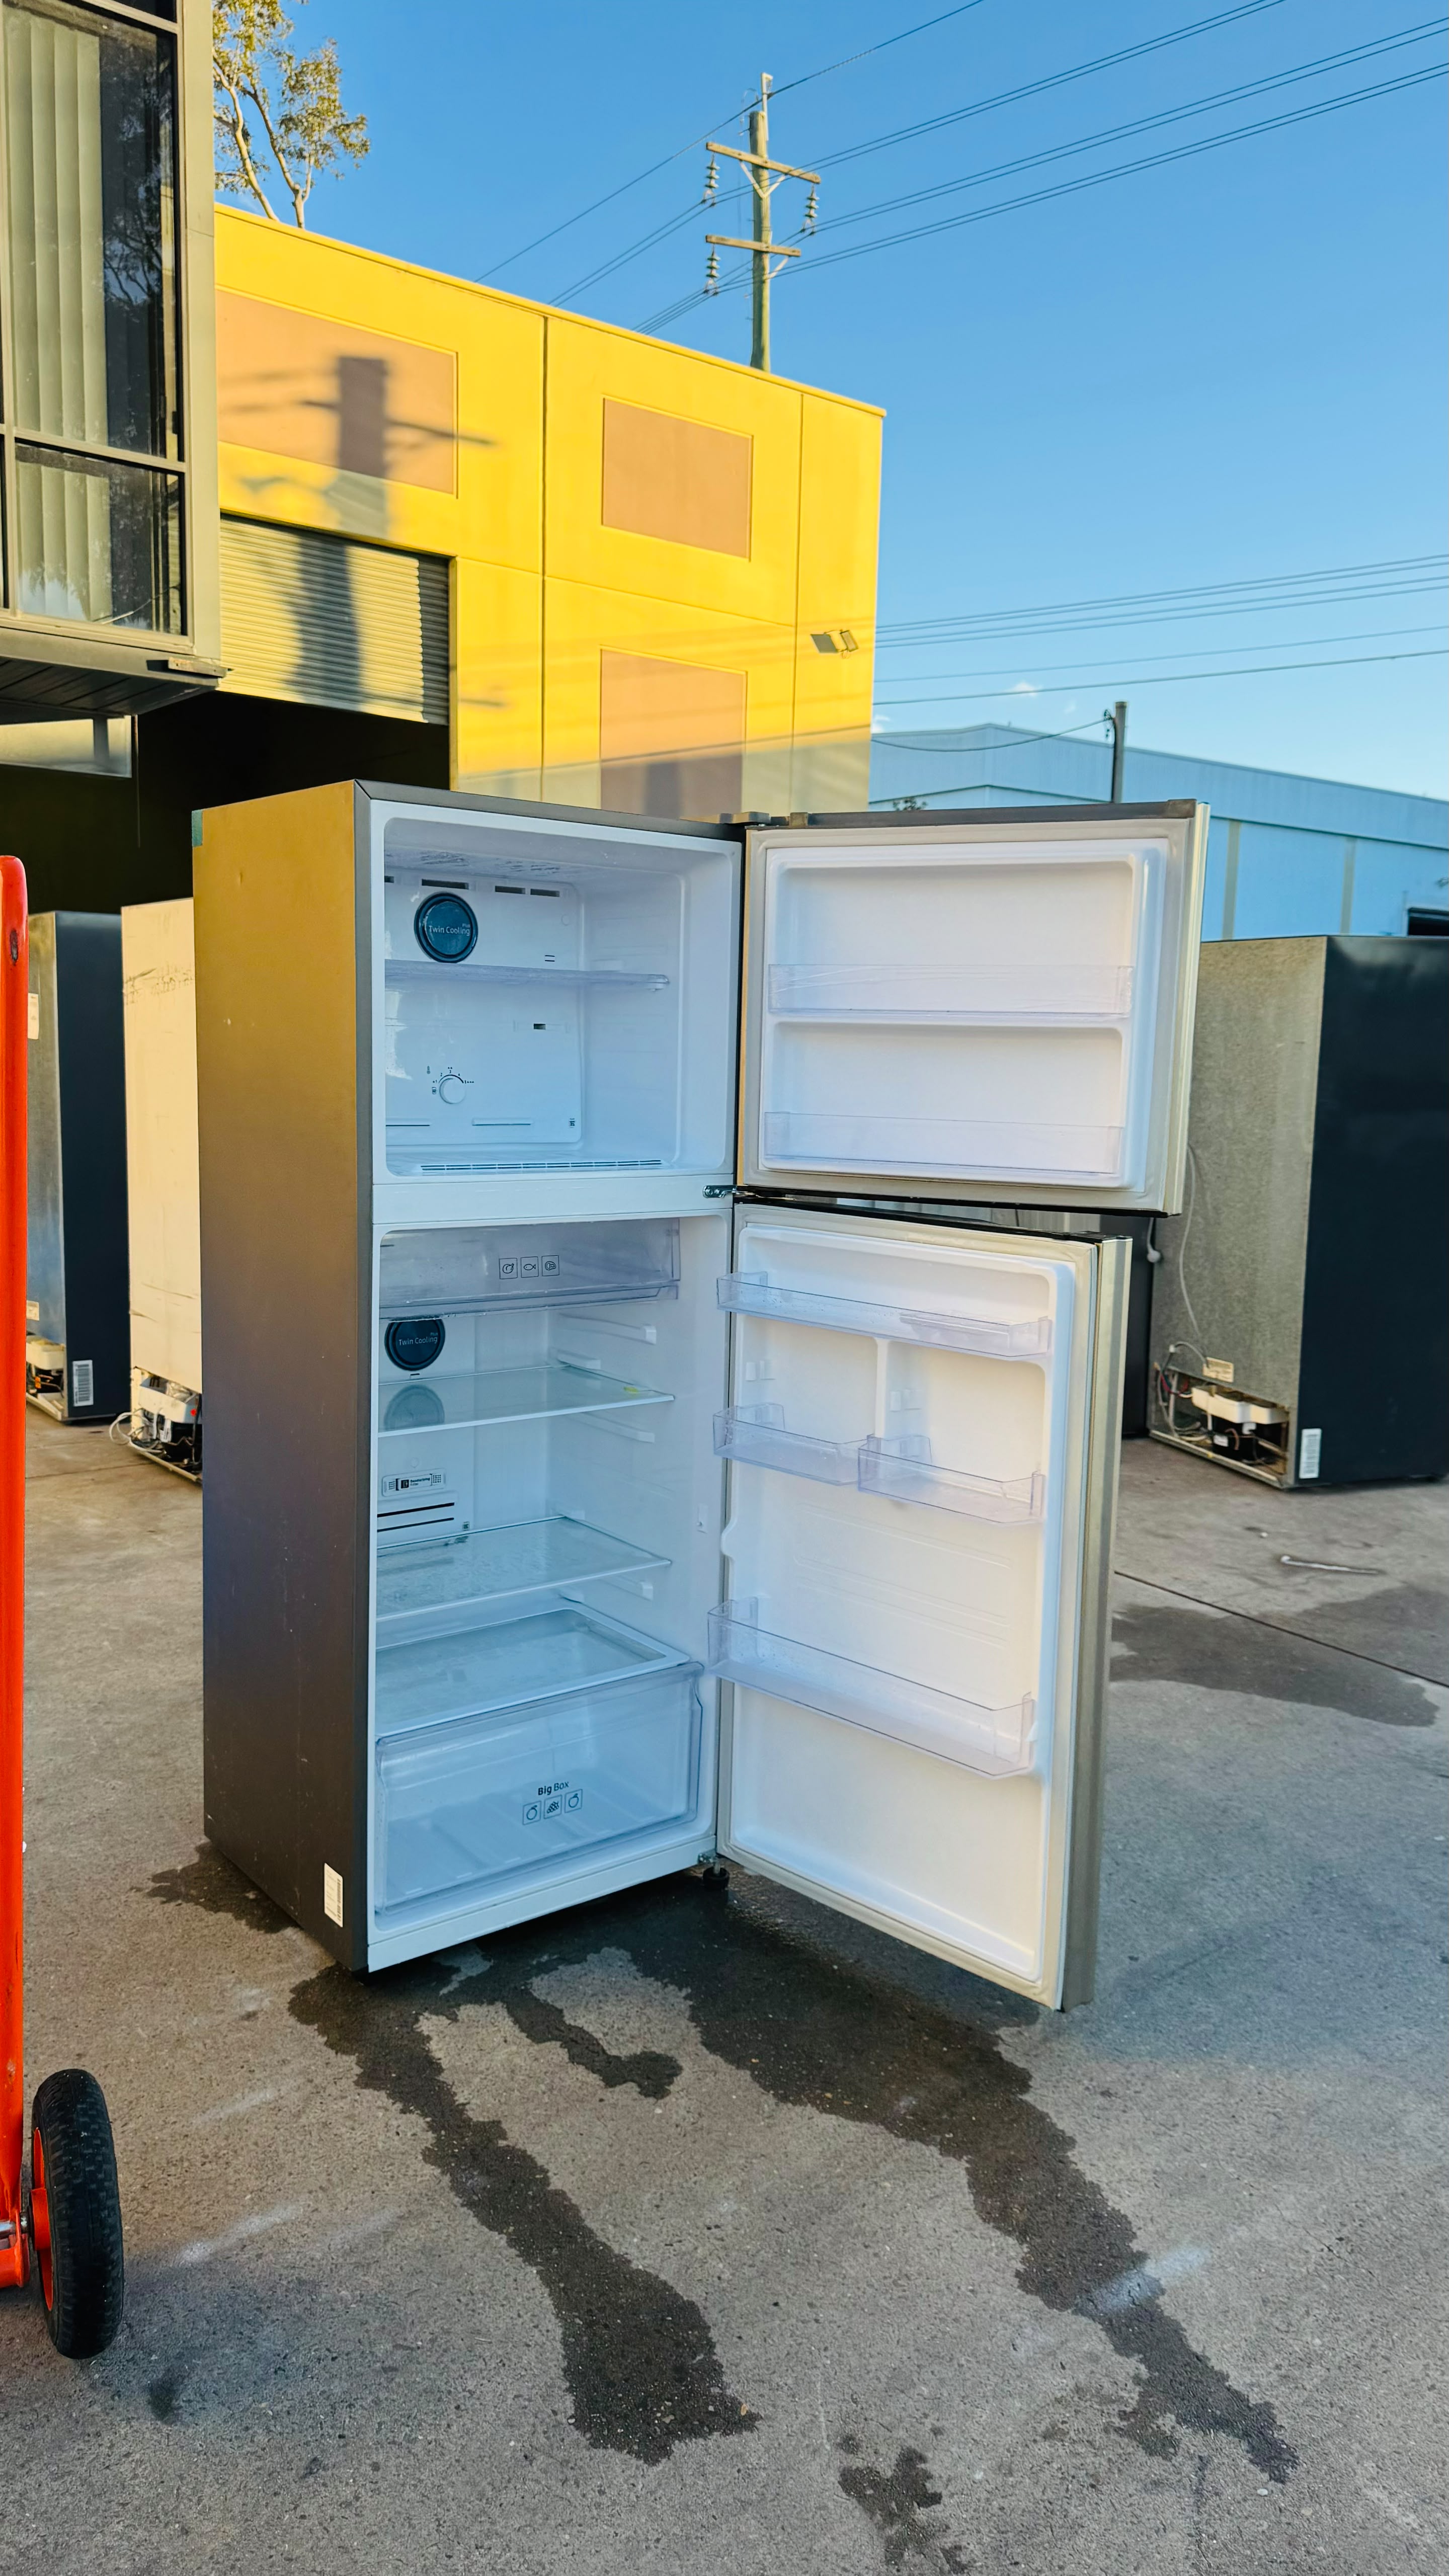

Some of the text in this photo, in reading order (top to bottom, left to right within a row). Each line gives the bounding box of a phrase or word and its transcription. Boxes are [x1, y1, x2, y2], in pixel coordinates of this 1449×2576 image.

[429, 925, 470, 936] Twin Cooling
[538, 1782, 569, 1796] Big Box
